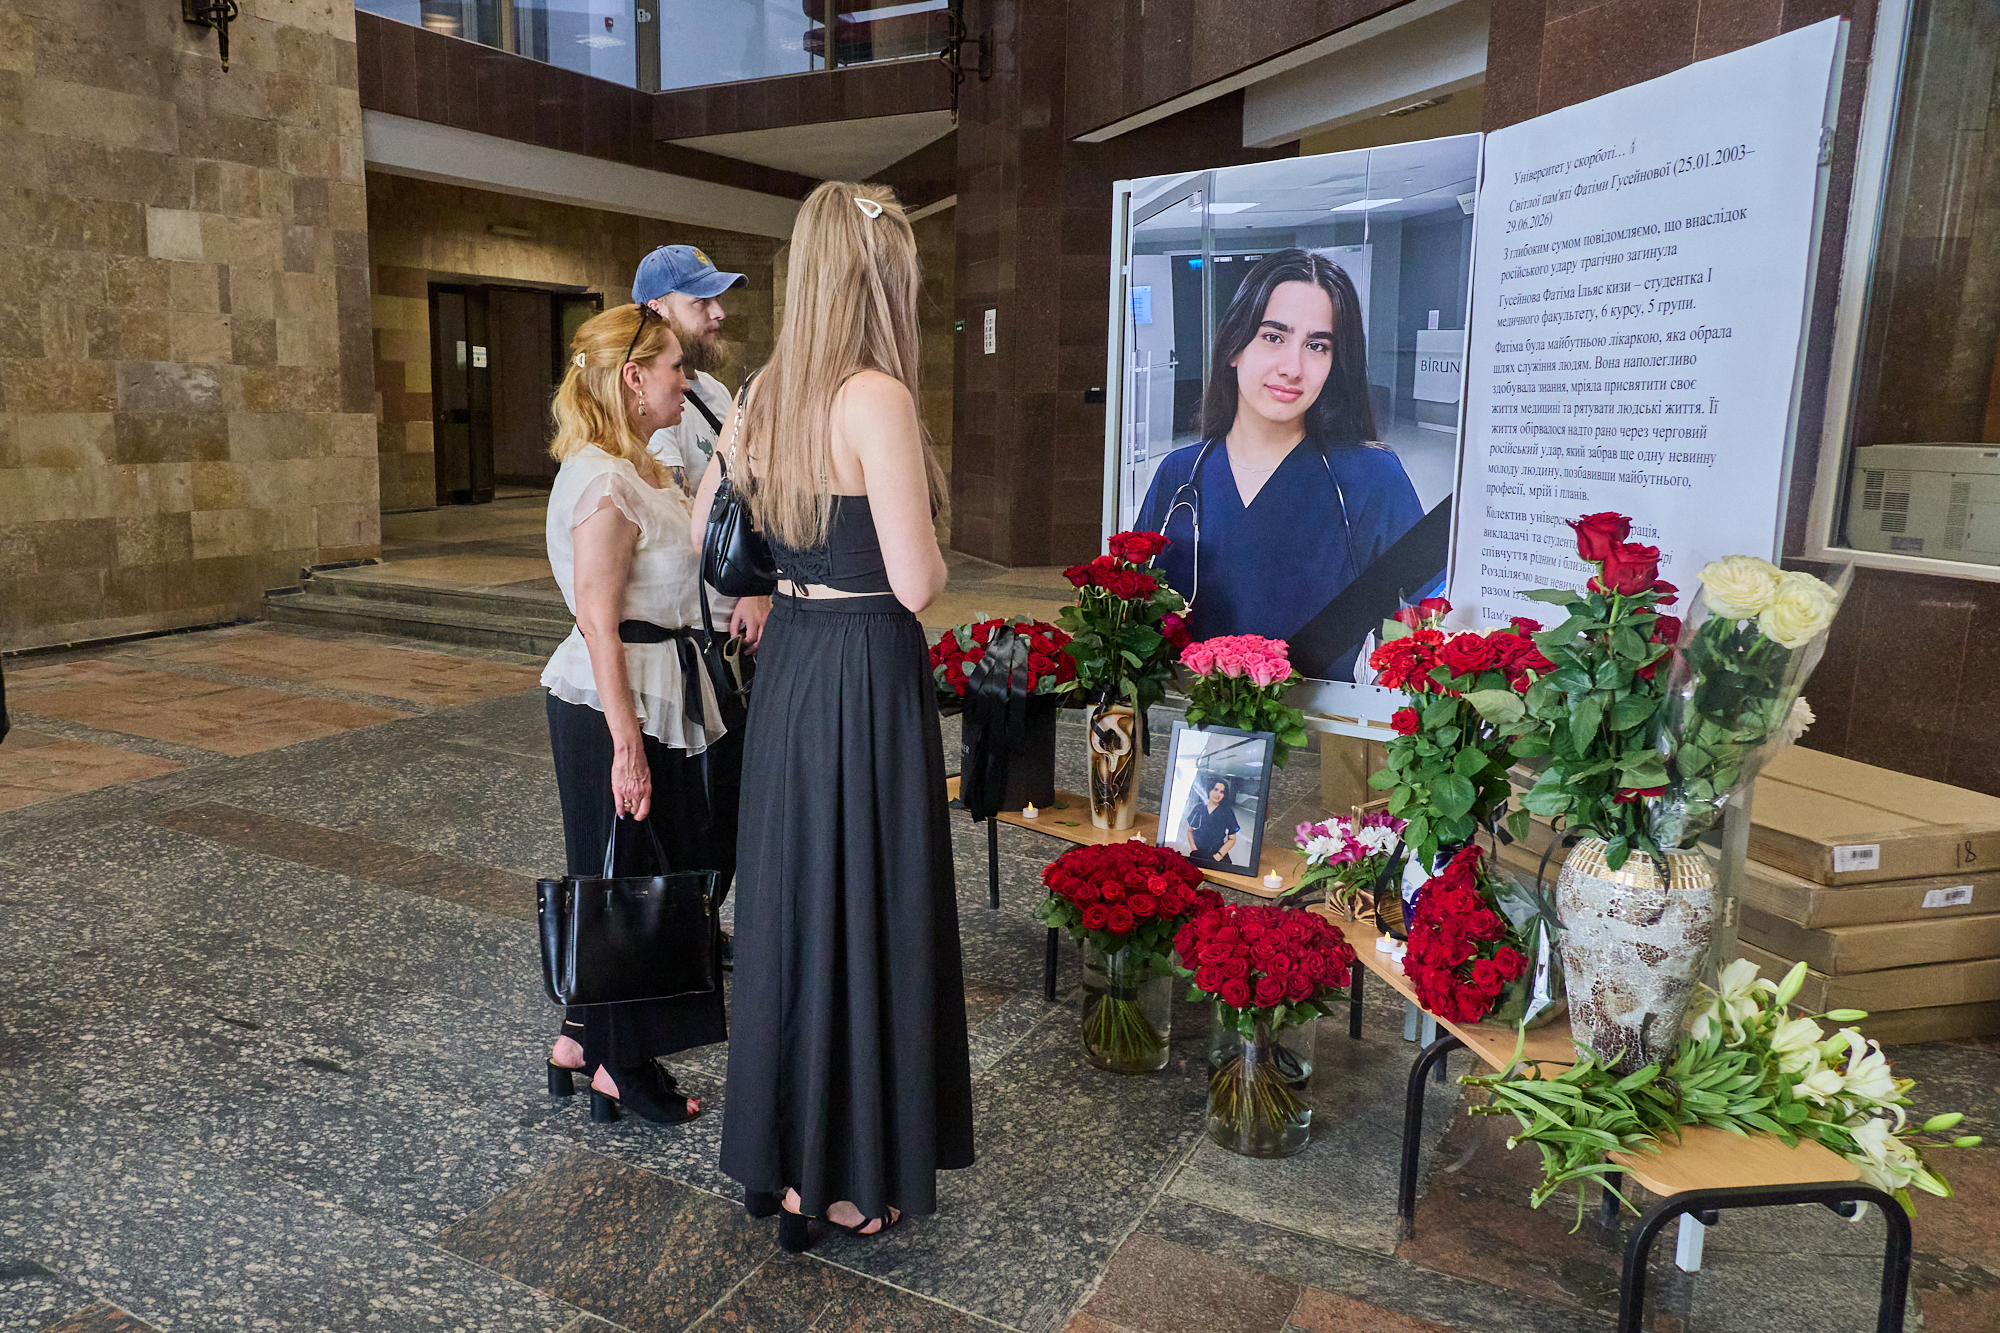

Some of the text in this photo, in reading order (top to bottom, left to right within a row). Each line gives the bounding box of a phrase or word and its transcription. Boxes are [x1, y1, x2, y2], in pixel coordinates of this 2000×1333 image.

[1514, 163, 1564, 184] Університет
[1565, 161, 1572, 174] у
[1509, 194, 1541, 212] Світлої
[1542, 189, 1571, 205] пам'яті
[1574, 180, 1609, 197] Фатіми
[1611, 166, 1669, 191] Гусейнової
[1504, 208, 1747, 260] З глибоким сумом повідомляємо, що внаслідок
[1506, 213, 1552, 233] 29.06.2026)
[1501, 245, 1677, 284] російського удару трагічно загинула
[1499, 293, 1540, 309] Гусейнова
[1543, 287, 1575, 301] Фатіма
[1578, 284, 1603, 297] Ільяс
[1606, 282, 1631, 294] кизи
[1644, 273, 1703, 292] студентка
[1497, 299, 1696, 327] медичного факультету, 6 курсу, 5 групи.
[1495, 325, 1731, 354] Фатіма була майбутньою лікаркою, яка обрала
[1494, 355, 1697, 375] шлях служіння людям. Вона наполегливо
[1493, 379, 1697, 396] здобувала знання, мріяла присвятити своє
[1492, 397, 1719, 417] життя медицині та рятувати людські життя. Її
[1492, 422, 1707, 442] життя обірвалося надто рано через черговий
[1489, 443, 1716, 467] російський удар, який забрав ще одну невинну
[1487, 463, 1692, 489] молоду людину, позбавивши майбутнього,
[1487, 482, 1525, 497] професії,
[1529, 484, 1551, 499] мрій
[1560, 489, 1589, 500] планів.
[1486, 506, 1527, 521] Колектив
[1484, 529, 1528, 541] викладачі
[1532, 534, 1541, 543] та
[1482, 546, 1527, 562] співчуття
[1530, 551, 1556, 566] рідним
[1482, 564, 1533, 582] Розділяємо
[1535, 575, 1548, 586] ваш
[1482, 586, 1509, 597] разом
[1956, 841, 1977, 868] 18
